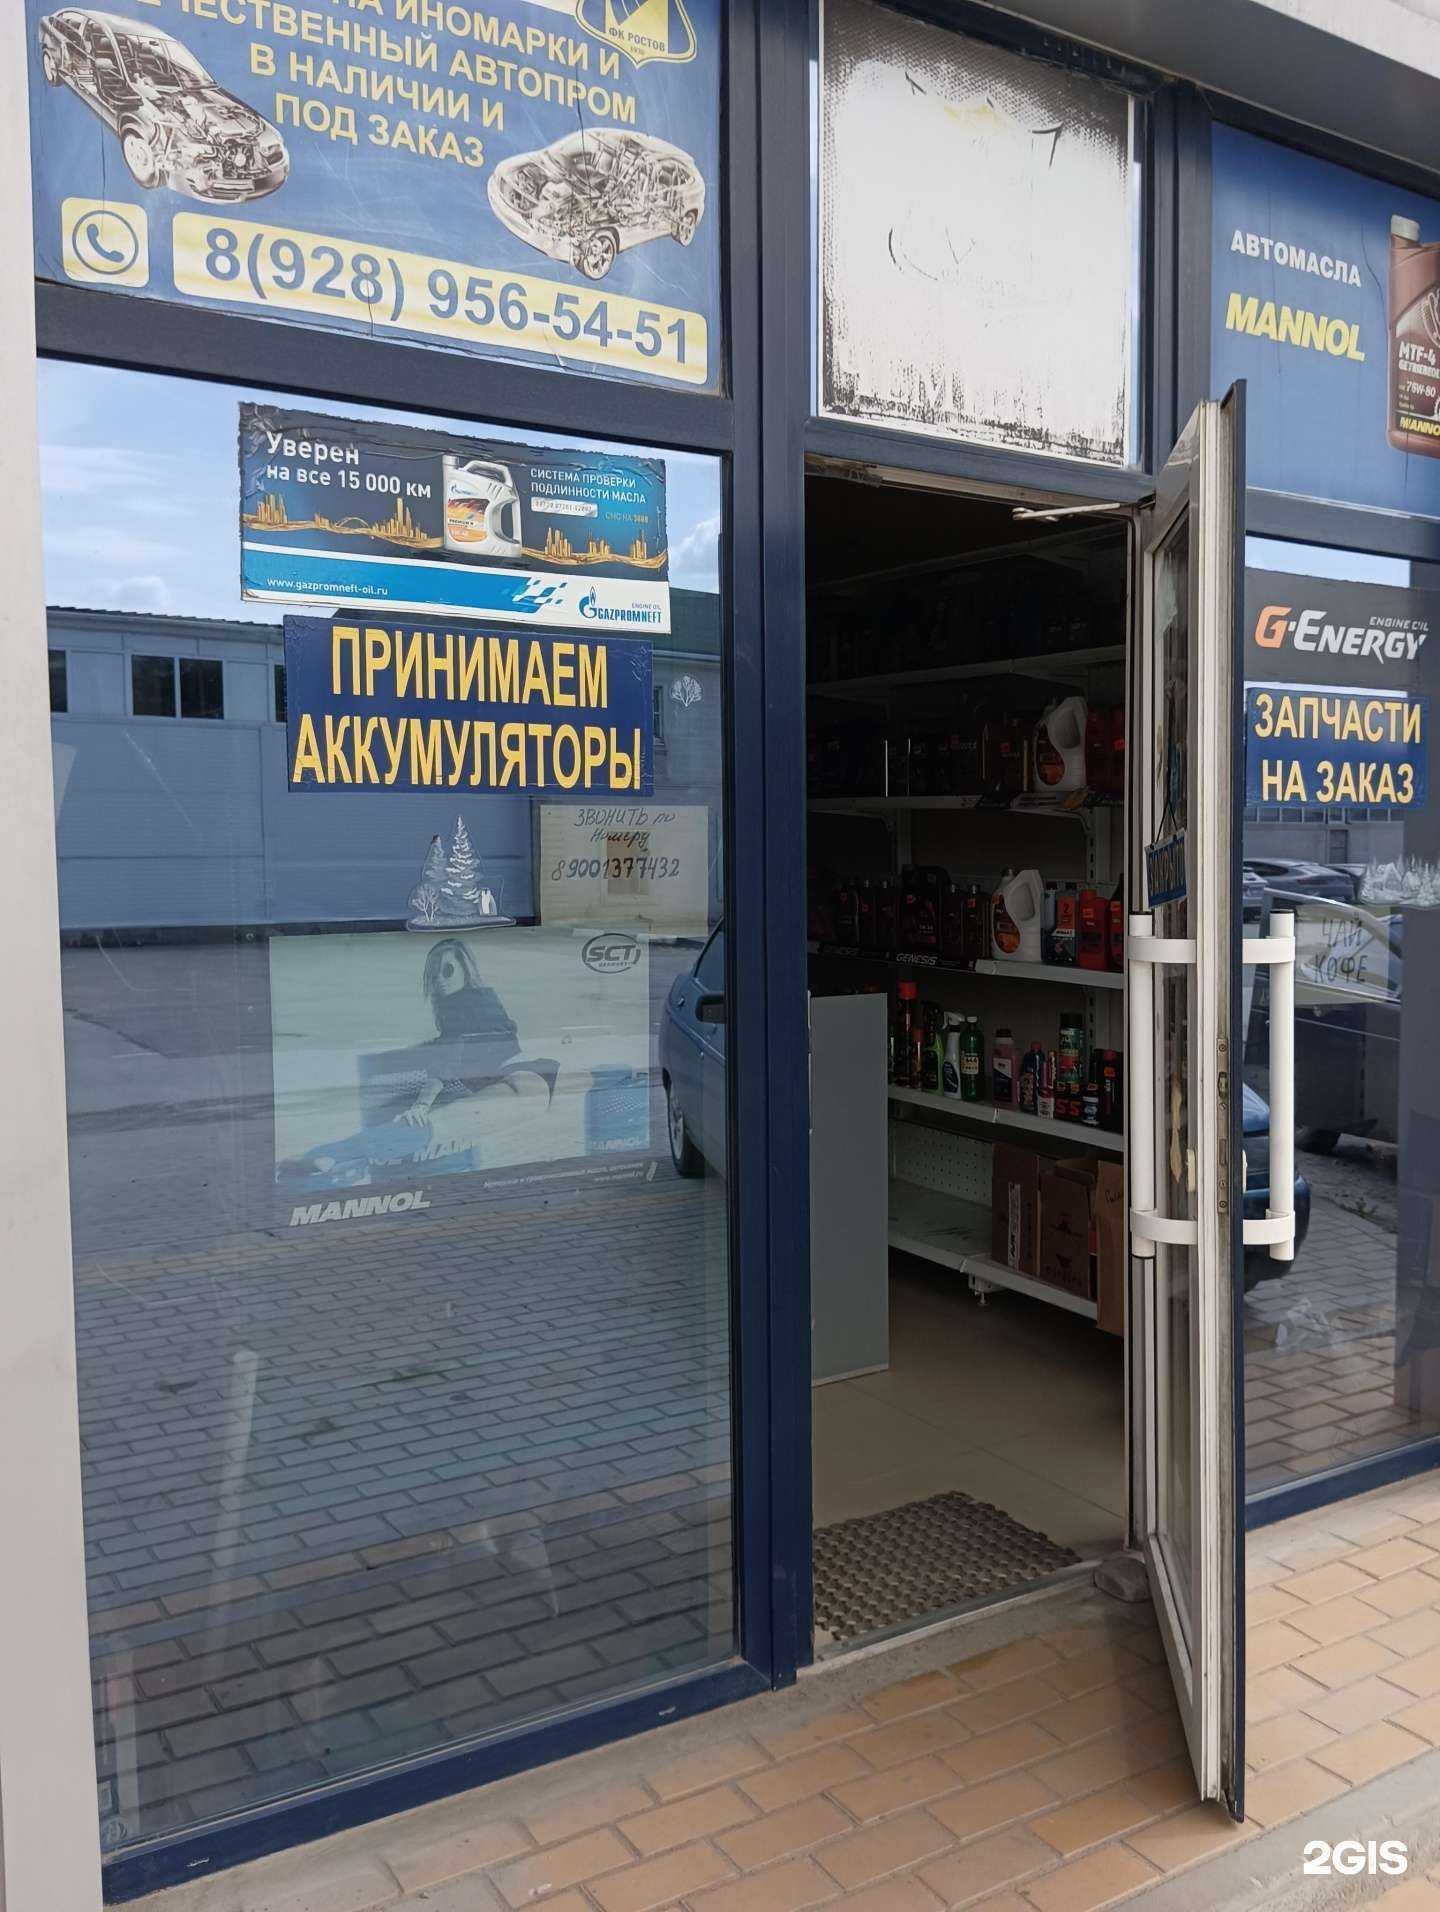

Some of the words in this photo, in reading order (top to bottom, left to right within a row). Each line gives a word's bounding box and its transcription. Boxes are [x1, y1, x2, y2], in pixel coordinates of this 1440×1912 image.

[395, 0, 588, 70] ИНОМАРКИ
[600, 48, 620, 79] И
[609, 27, 624, 41] ФК
[628, 32, 665, 52] РОСТОВ
[137, 0, 438, 73] ЕСТВЕННЫЙ
[449, 49, 636, 125] АВТОПРОМ
[250, 42, 276, 76] В
[290, 51, 470, 123] НАЛИЧИИ
[482, 97, 504, 131] И
[275, 92, 358, 146] ПОД
[368, 114, 484, 168] ЗАКАЗ
[1230, 229, 1362, 287] АВТОМАСЛА
[204, 227, 405, 322] 8(928)
[429, 268, 688, 364] 956-54-51
[1225, 292, 1366, 362] MANNOL
[1399, 341, 1437, 366] MTF-4
[1400, 416, 1440, 437] MANNO
[266, 431, 360, 466] Уверен
[266, 465, 290, 481] на
[297, 468, 331, 486] все
[338, 470, 360, 489] 15
[366, 473, 401, 495] 000
[406, 482, 432, 498] км
[531, 468, 580, 483] СИСТЕМА
[583, 473, 636, 488] ПРОВЕРКИ
[531, 482, 610, 500] ПОДЛИННОСТИ
[612, 490, 646, 504] МАСЛА
[267, 577, 388, 595] www.gazpromneft-oil.ru
[598, 607, 662, 624] GAZPROMNEFT
[1369, 616, 1411, 630] ENGINE
[332, 625, 608, 709] ПРИНИМАЕМ
[1255, 693, 1422, 744] ЗАПЧАСТИ
[292, 713, 641, 790] АККУМУЛЯТОРЫ
[1262, 759, 1307, 801] НА
[1316, 760, 1414, 804] ЗАКАЗ
[587, 944, 637, 962] SCT
[1314, 953, 1368, 983] КОФЕ
[290, 1189, 431, 1227] MANNOL
